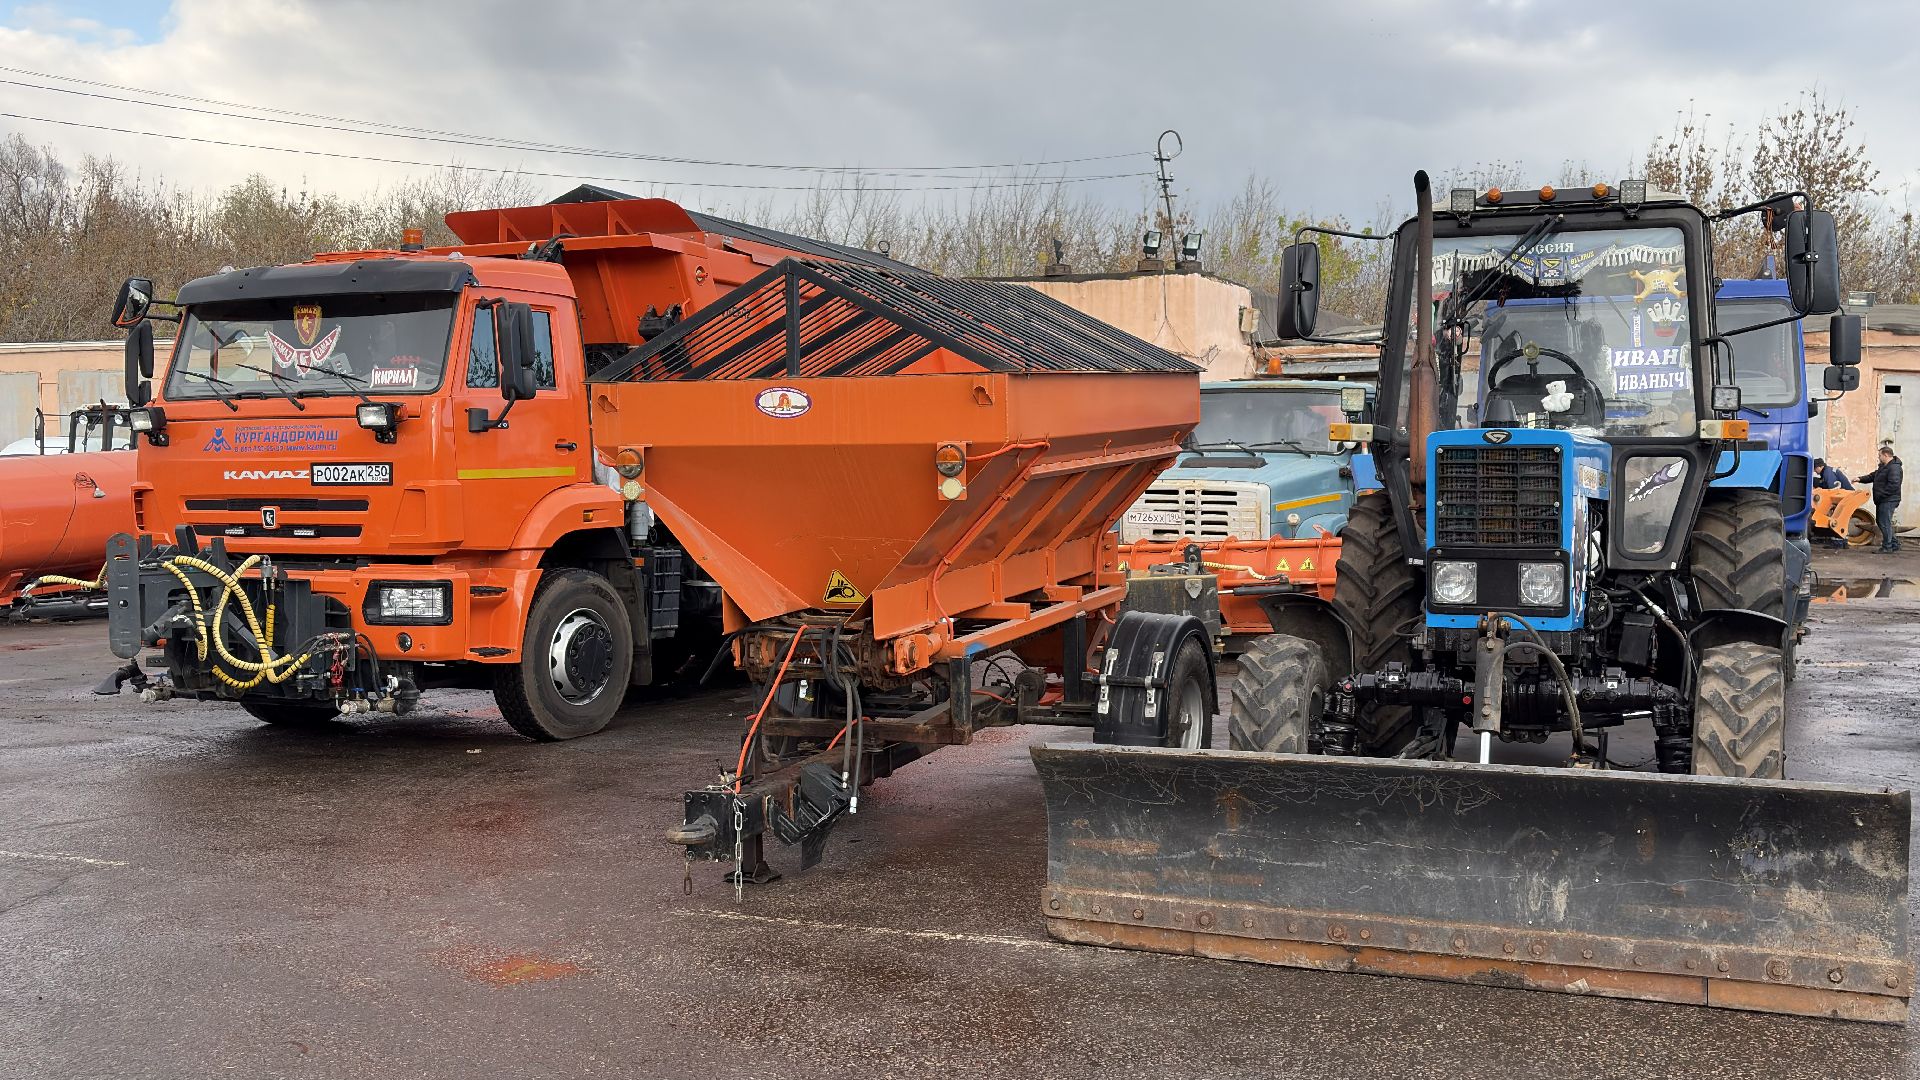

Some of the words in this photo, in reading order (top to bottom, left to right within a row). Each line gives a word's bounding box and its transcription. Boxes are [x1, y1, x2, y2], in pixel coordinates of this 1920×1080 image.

[1614, 349, 1679, 367] ИВАН
[374, 369, 412, 385] КИРИЛЛ
[1619, 371, 1685, 390] ИВАНЫЧ
[235, 430, 339, 444] КУРГАНДОРМАШ
[223, 470, 310, 480] KAMAZ
[367, 465, 388, 477] 250
